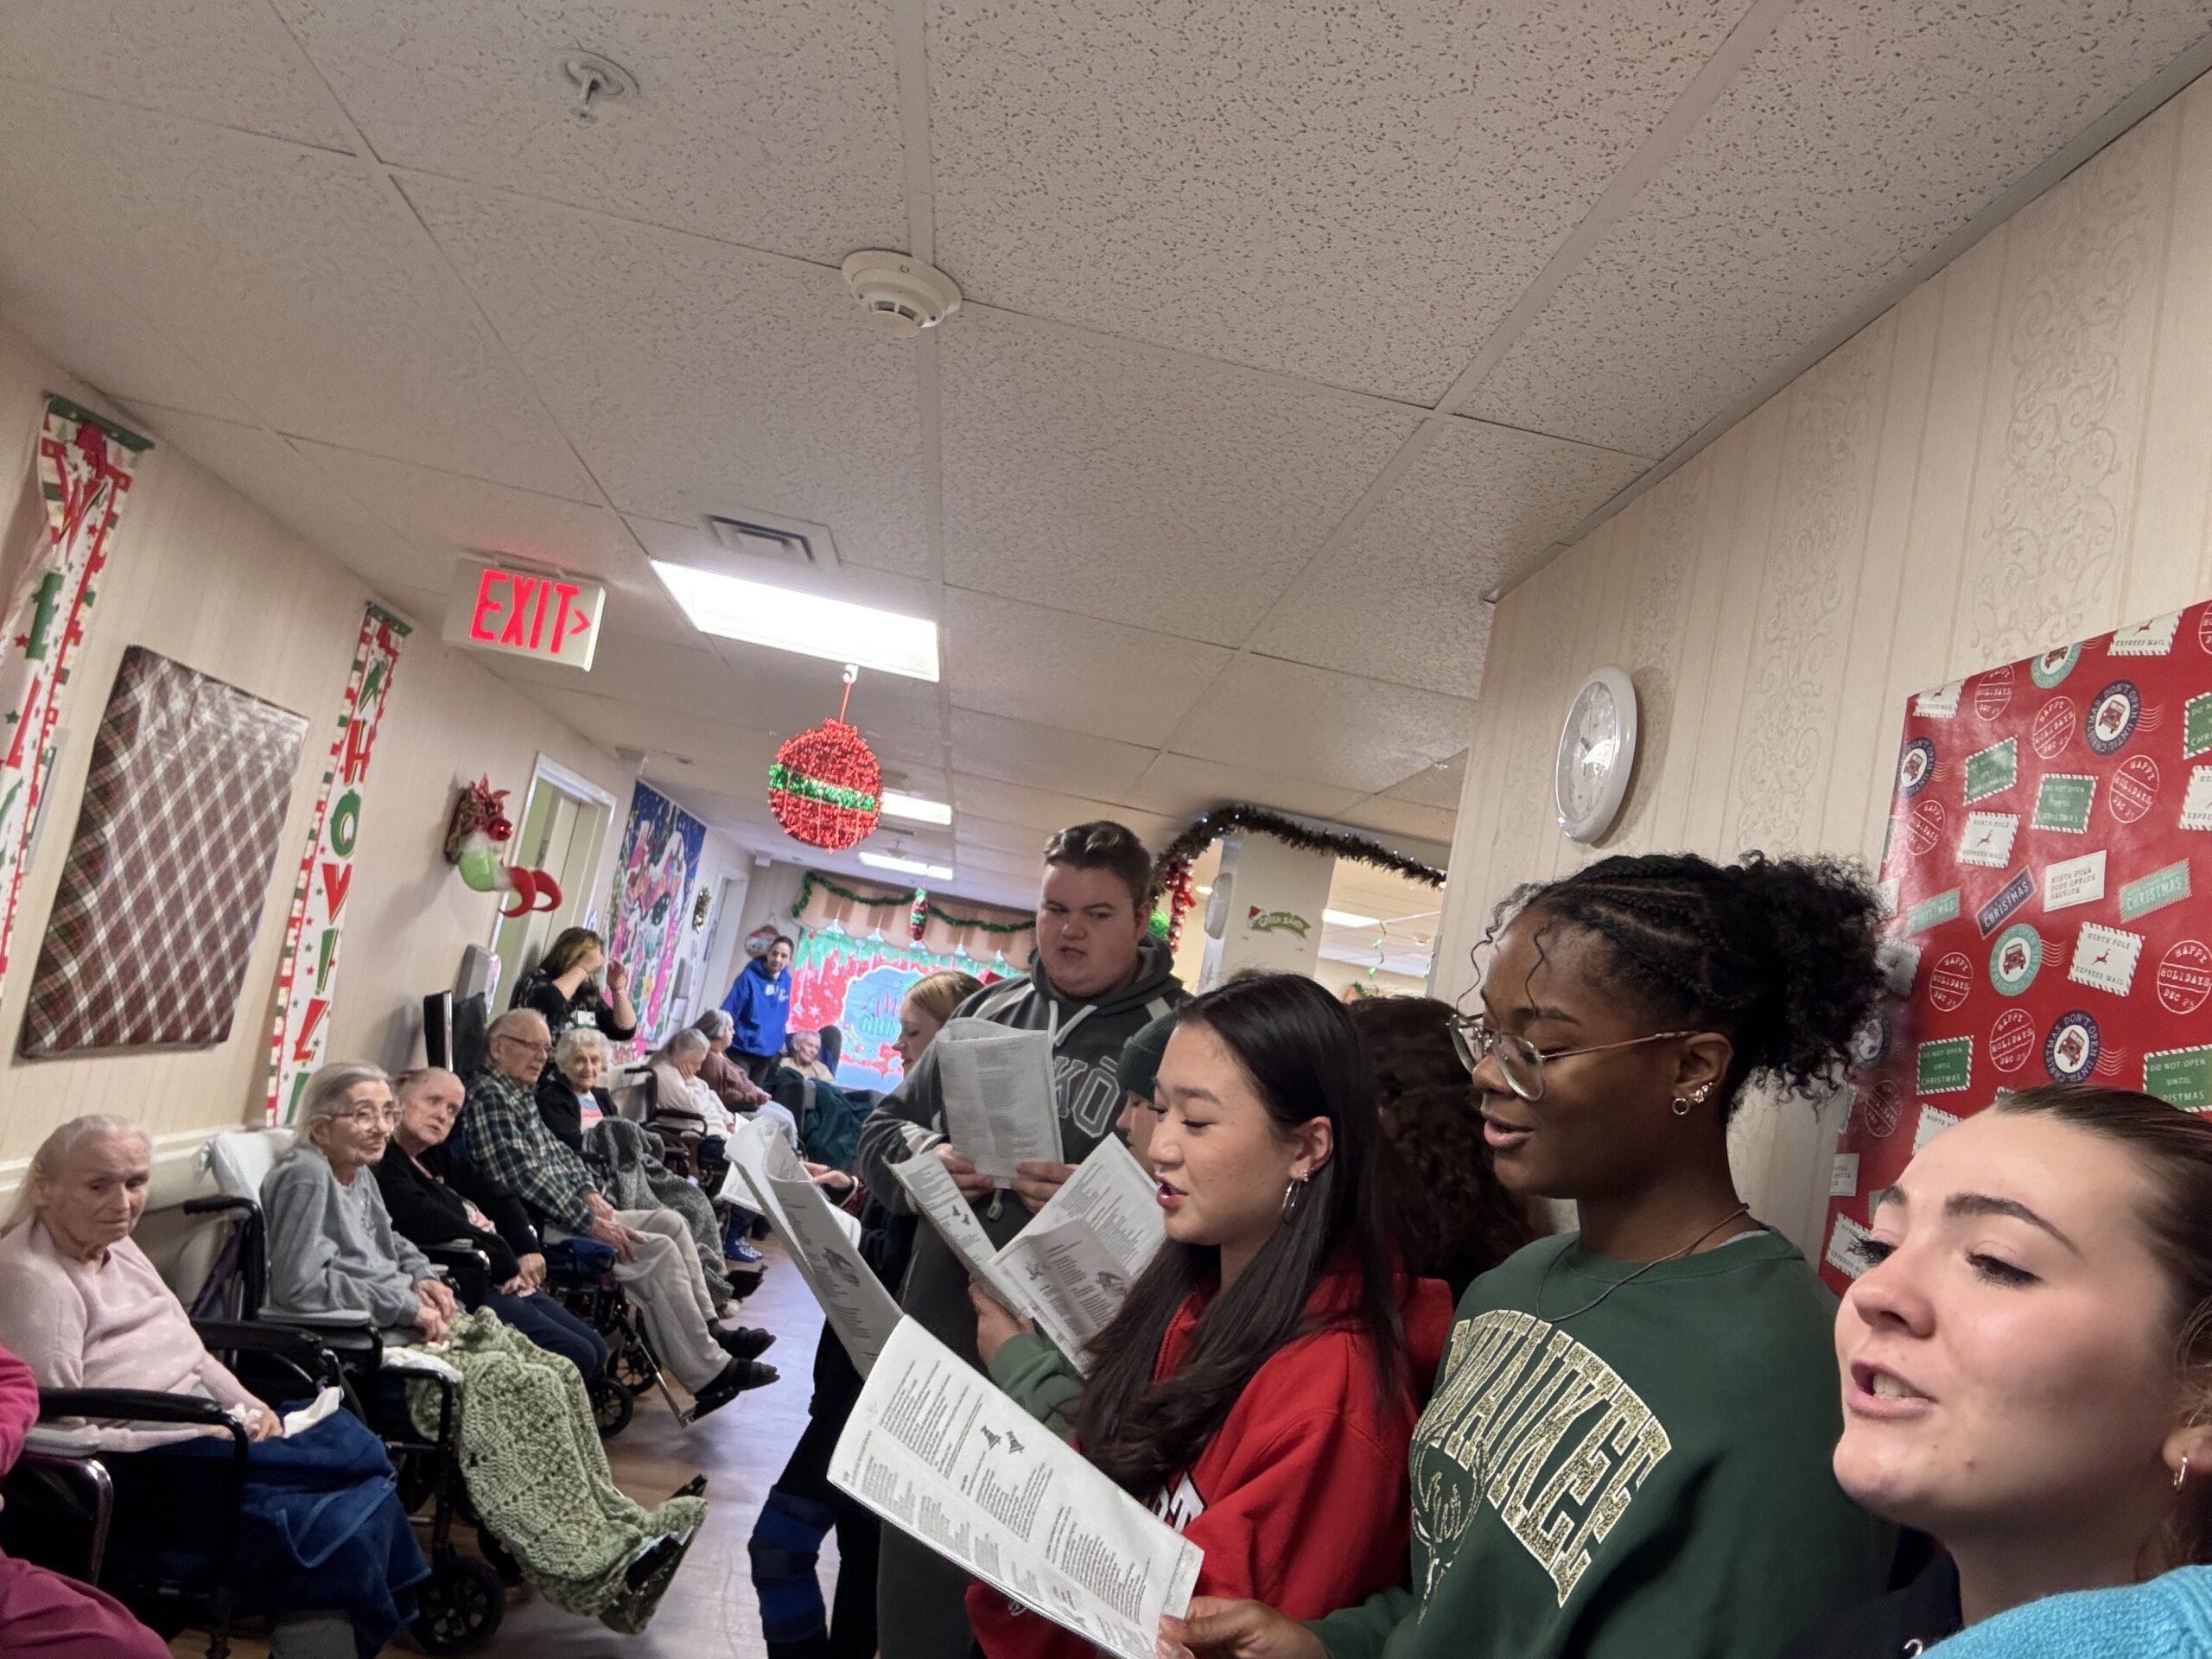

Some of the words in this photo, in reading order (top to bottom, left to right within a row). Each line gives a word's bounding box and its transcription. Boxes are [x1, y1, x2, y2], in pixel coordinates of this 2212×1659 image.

[470, 569, 580, 654] EXIT
[2130, 760, 2155, 780] HAPPY
[2114, 777, 2152, 805] HOLIDAYS
[2126, 876, 2183, 911] CHRISTMAS
[1983, 881, 2029, 928] CHRISTMAS
[2088, 932, 2110, 944] NORTH
[2112, 938, 2131, 950] POLE
[2175, 945, 2207, 963] HAPPY
[1944, 957, 1968, 971] HAPPY
[1932, 975, 1970, 990] HOLIDAYS
[2075, 966, 2104, 980] EXPRESS
[2106, 973, 2125, 986] MAIL
[2160, 968, 2210, 987] HOLIDAYS
[2164, 988, 2181, 1001] DEC
[2183, 998, 2195, 1009] 25
[1998, 1013, 2023, 1031] HAPPY
[1991, 1028, 2033, 1052] HOLIDAYS
[2063, 1013, 2091, 1025] DON'T
[2088, 1026, 2099, 1057] OPEN
[1946, 1046, 1962, 1055] OPEN
[2150, 1064, 2162, 1072] DO
[2164, 1061, 2181, 1070] NOT
[2183, 1058, 2206, 1068] OPEN
[1921, 1074, 1961, 1086] CHRISTMAS
[2166, 1076, 2191, 1086] UNTIL
